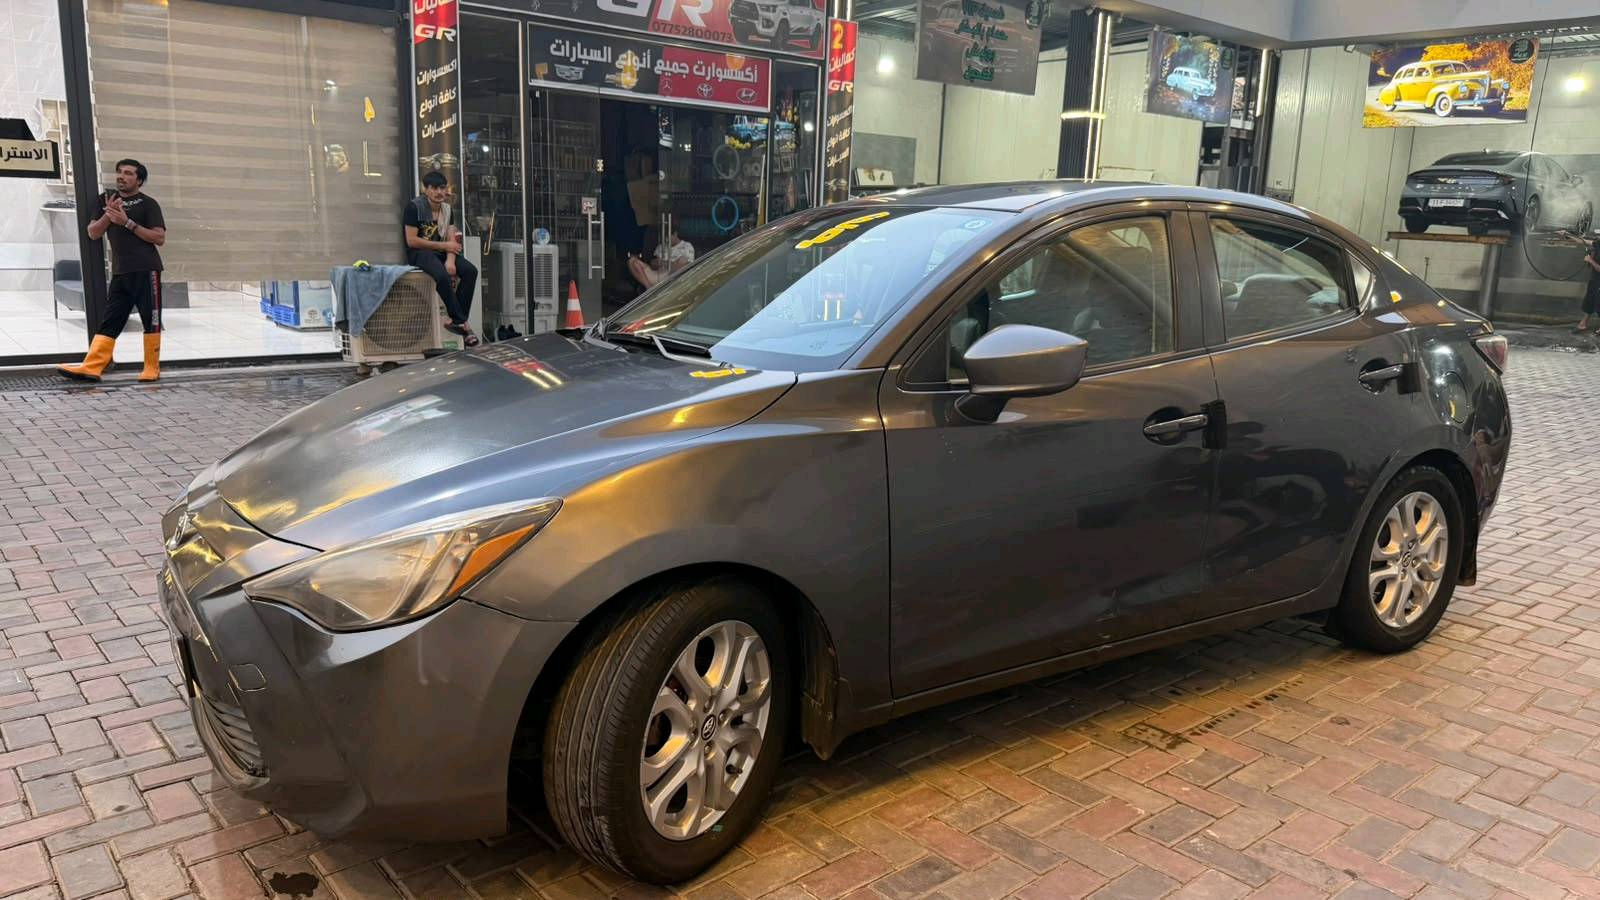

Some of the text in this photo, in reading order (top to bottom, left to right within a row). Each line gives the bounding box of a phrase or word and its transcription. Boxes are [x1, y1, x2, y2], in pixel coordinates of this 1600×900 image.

[415, 23, 457, 42] GR
[652, 20, 734, 42] 07752800073
[550, 38, 612, 64] السيارات
[416, 58, 457, 85] اكسسوارات
[654, 59, 689, 78] جميع
[828, 80, 854, 93] GR
[419, 86, 457, 119] كافة انواع
[421, 113, 457, 139] السيارات
